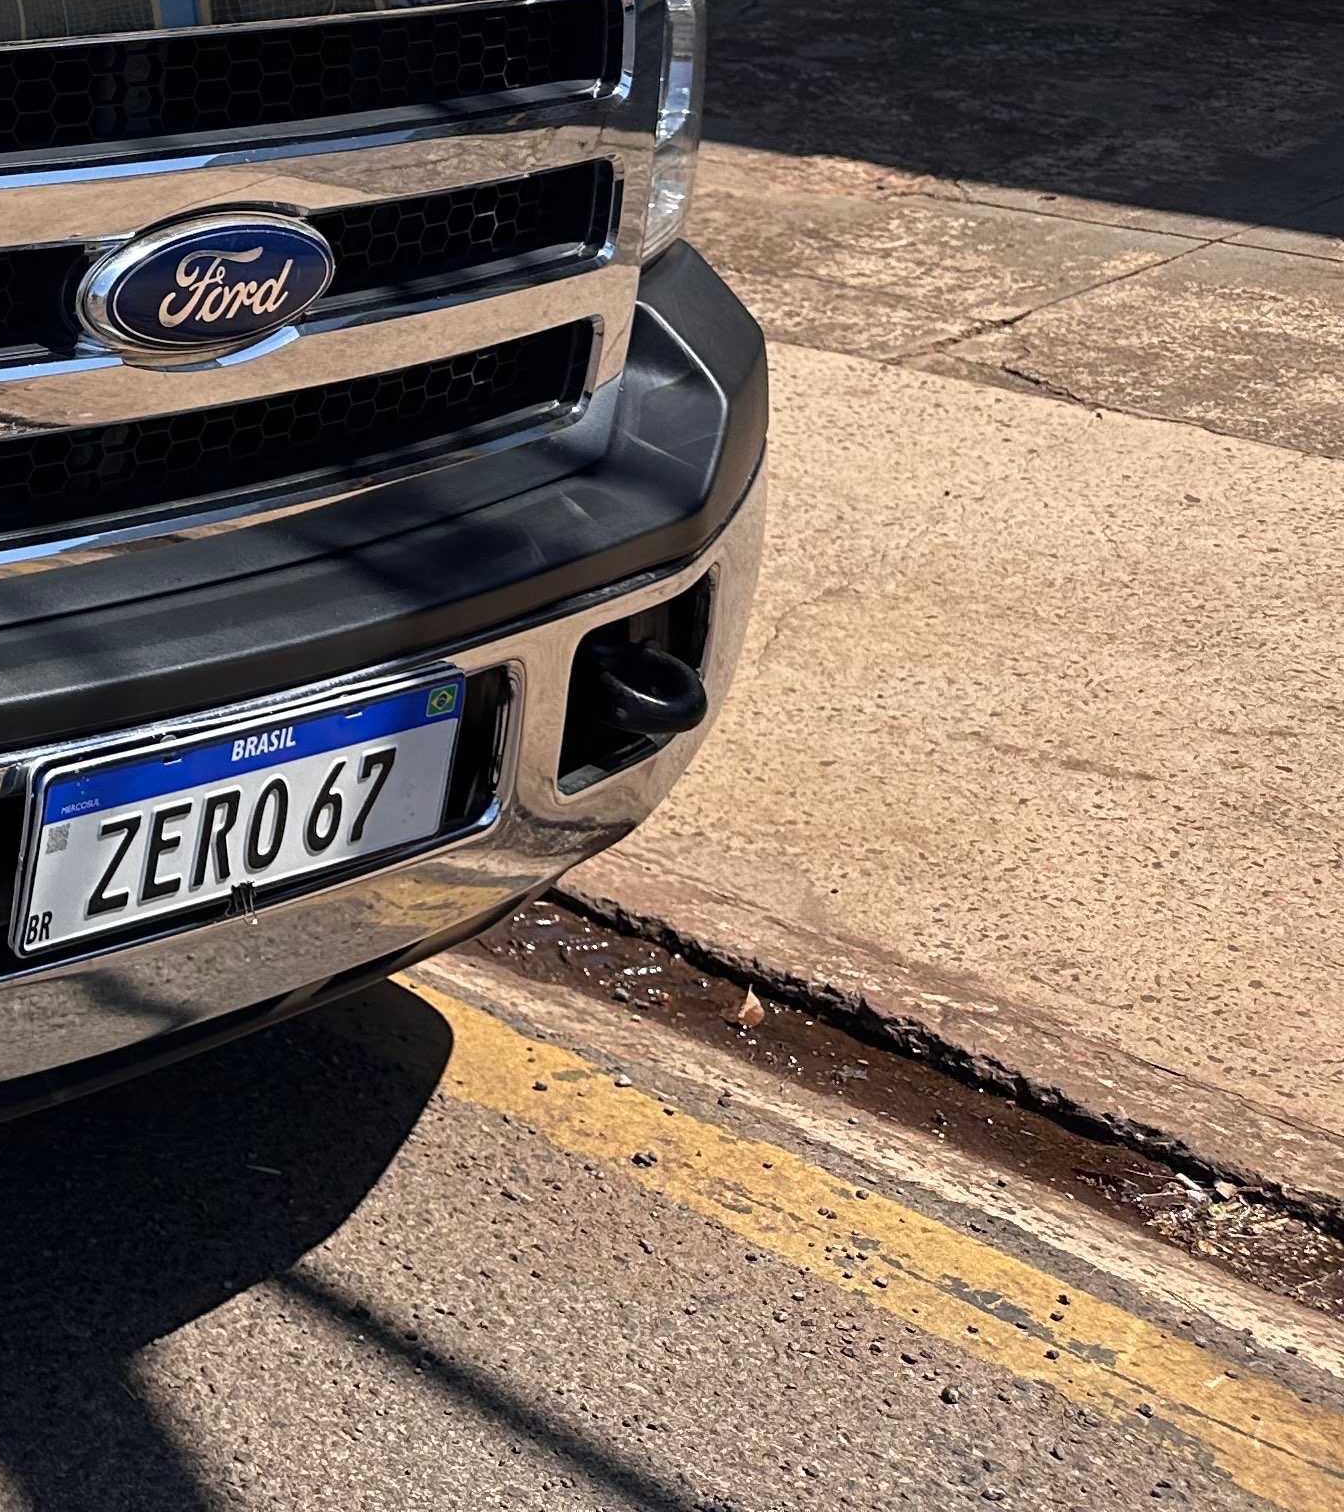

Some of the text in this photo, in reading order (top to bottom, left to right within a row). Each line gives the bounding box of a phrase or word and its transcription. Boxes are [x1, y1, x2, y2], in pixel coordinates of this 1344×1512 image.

[158, 246, 294, 328] Ford
[230, 725, 297, 763] BRASIL
[60, 798, 100, 815] MERCOSUL
[86, 747, 397, 917] ZERO 67
[25, 910, 53, 945] BR
